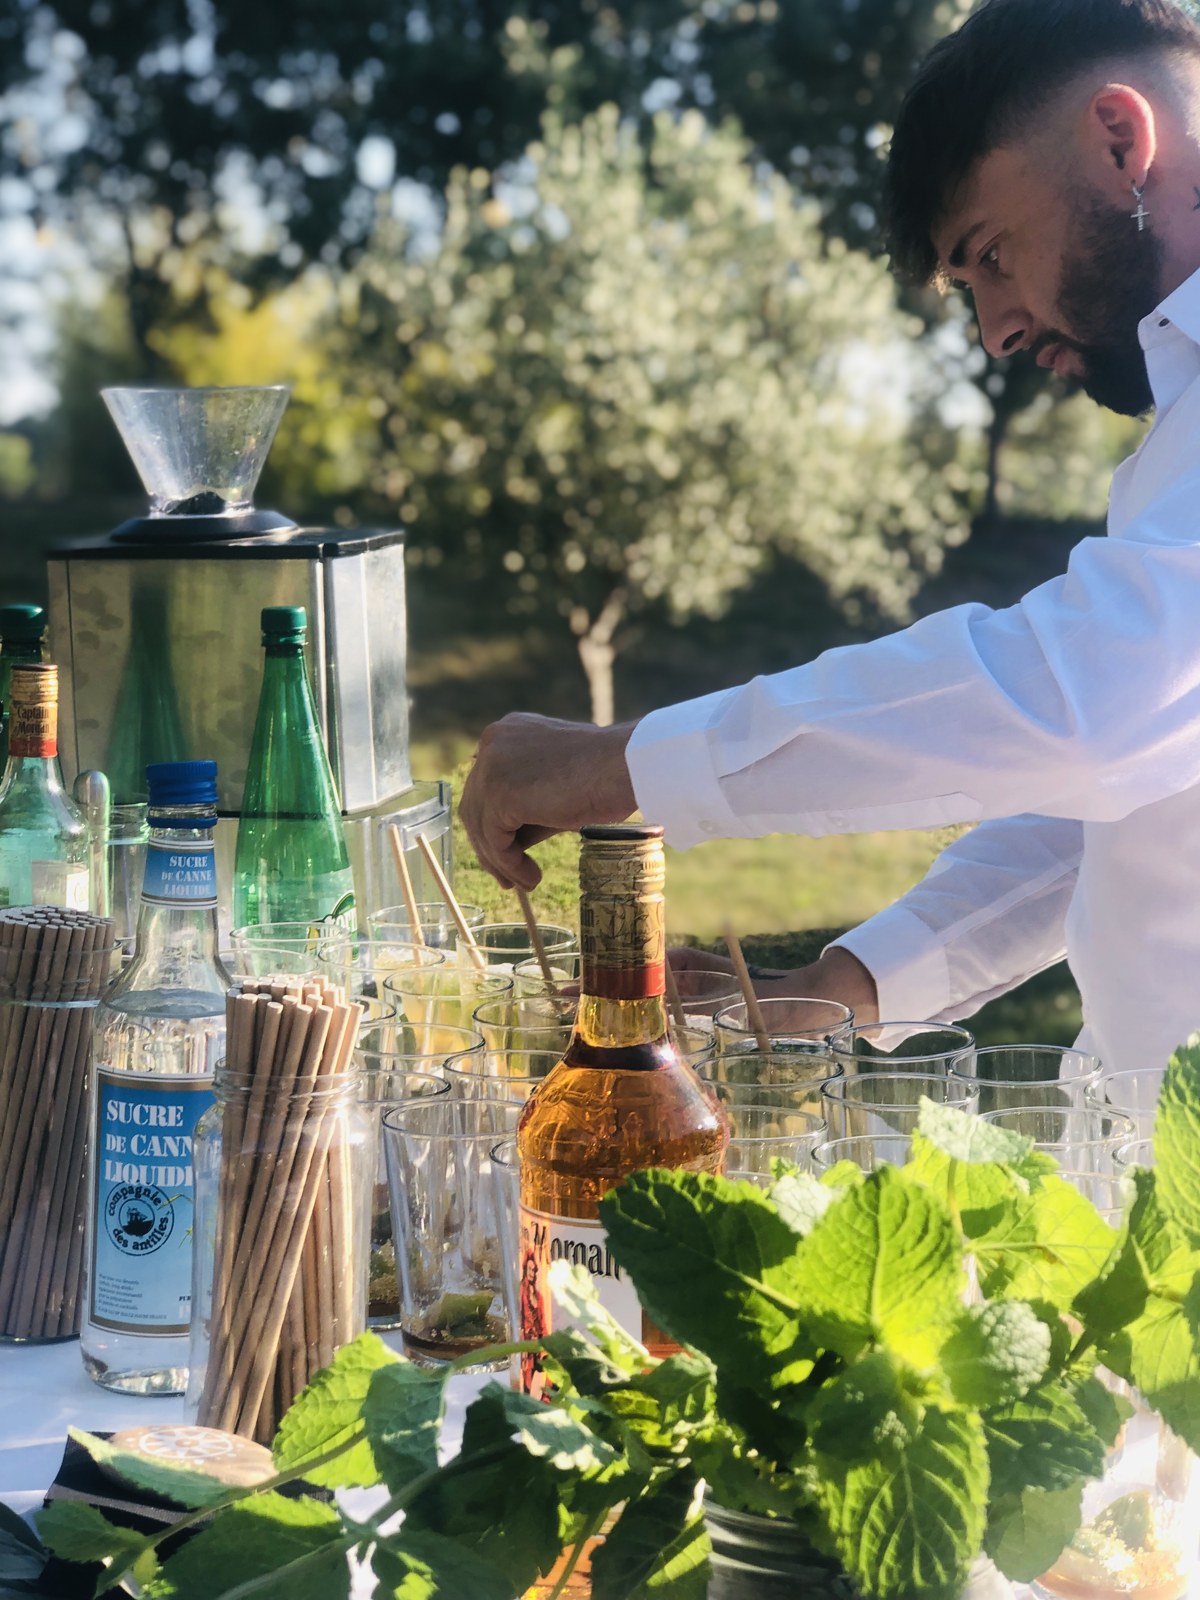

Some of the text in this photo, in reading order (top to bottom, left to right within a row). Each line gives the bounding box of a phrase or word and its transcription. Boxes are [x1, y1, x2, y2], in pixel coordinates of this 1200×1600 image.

[17, 705, 50, 721] Captain
[17, 721, 50, 736] Morgan
[169, 855, 209, 868] SUCRE
[161, 870, 213, 882] DE CANNE
[163, 883, 212, 897] LIQUIDE
[106, 1099, 184, 1127] SUCRE
[105, 1133, 193, 1157] DE CANN
[108, 1184, 162, 1217] compagnie
[112, 1216, 169, 1251] des antilles
